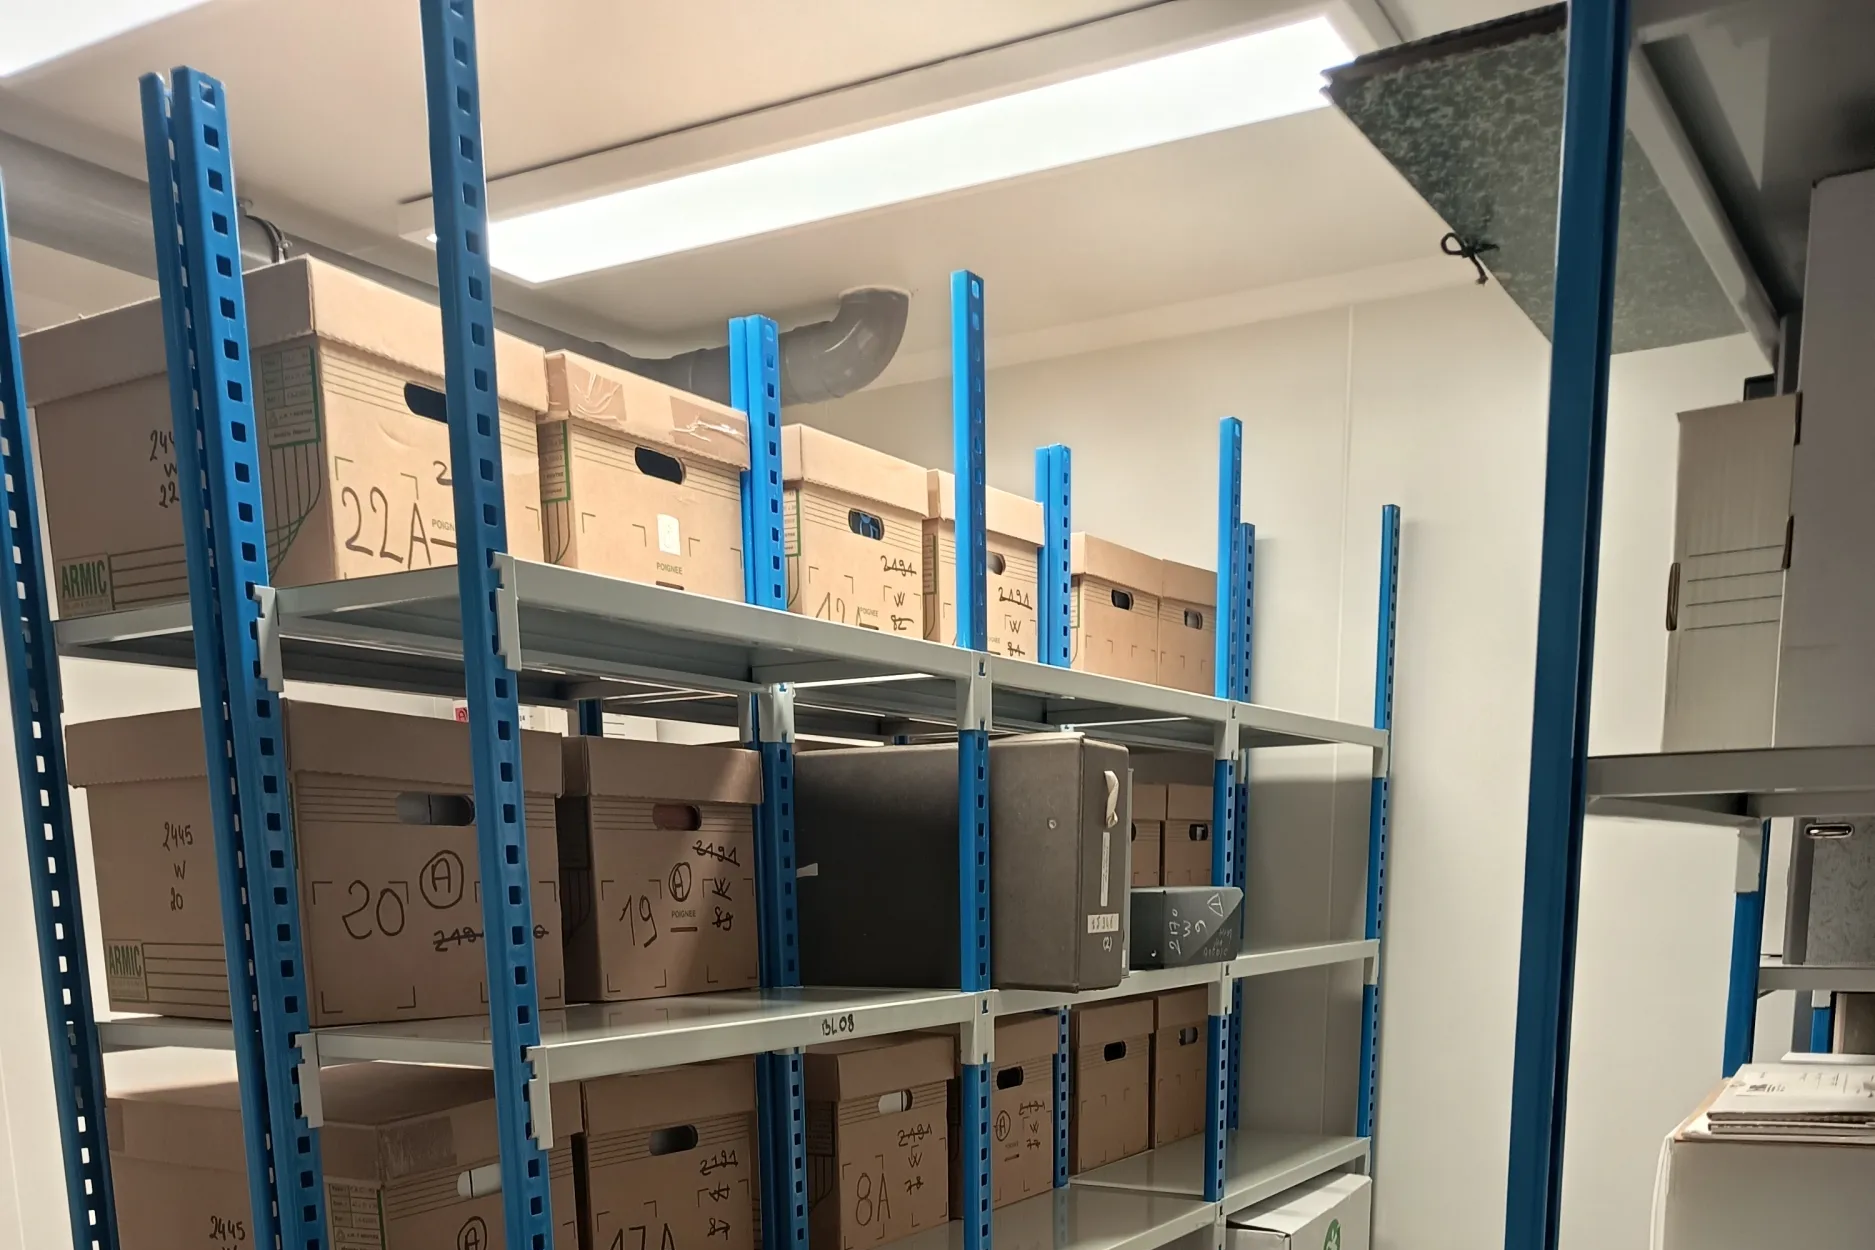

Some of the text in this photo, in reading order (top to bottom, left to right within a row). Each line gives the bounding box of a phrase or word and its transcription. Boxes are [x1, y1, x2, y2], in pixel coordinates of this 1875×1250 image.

[341, 486, 431, 569] 22A
[61, 559, 108, 599] ARMIC
[656, 561, 683, 576] POIGNEE
[893, 591, 906, 608] W
[1009, 619, 1022, 634] W
[163, 821, 194, 851] 2445
[174, 860, 186, 880] W
[342, 879, 405, 940] 20
[619, 894, 658, 948] 19
[671, 909, 697, 919] POIGNEE
[108, 945, 142, 978] ARMIC
[1029, 1121, 1039, 1134] W
[856, 1172, 891, 1227] 8A
[209, 1215, 246, 1242] 2445
